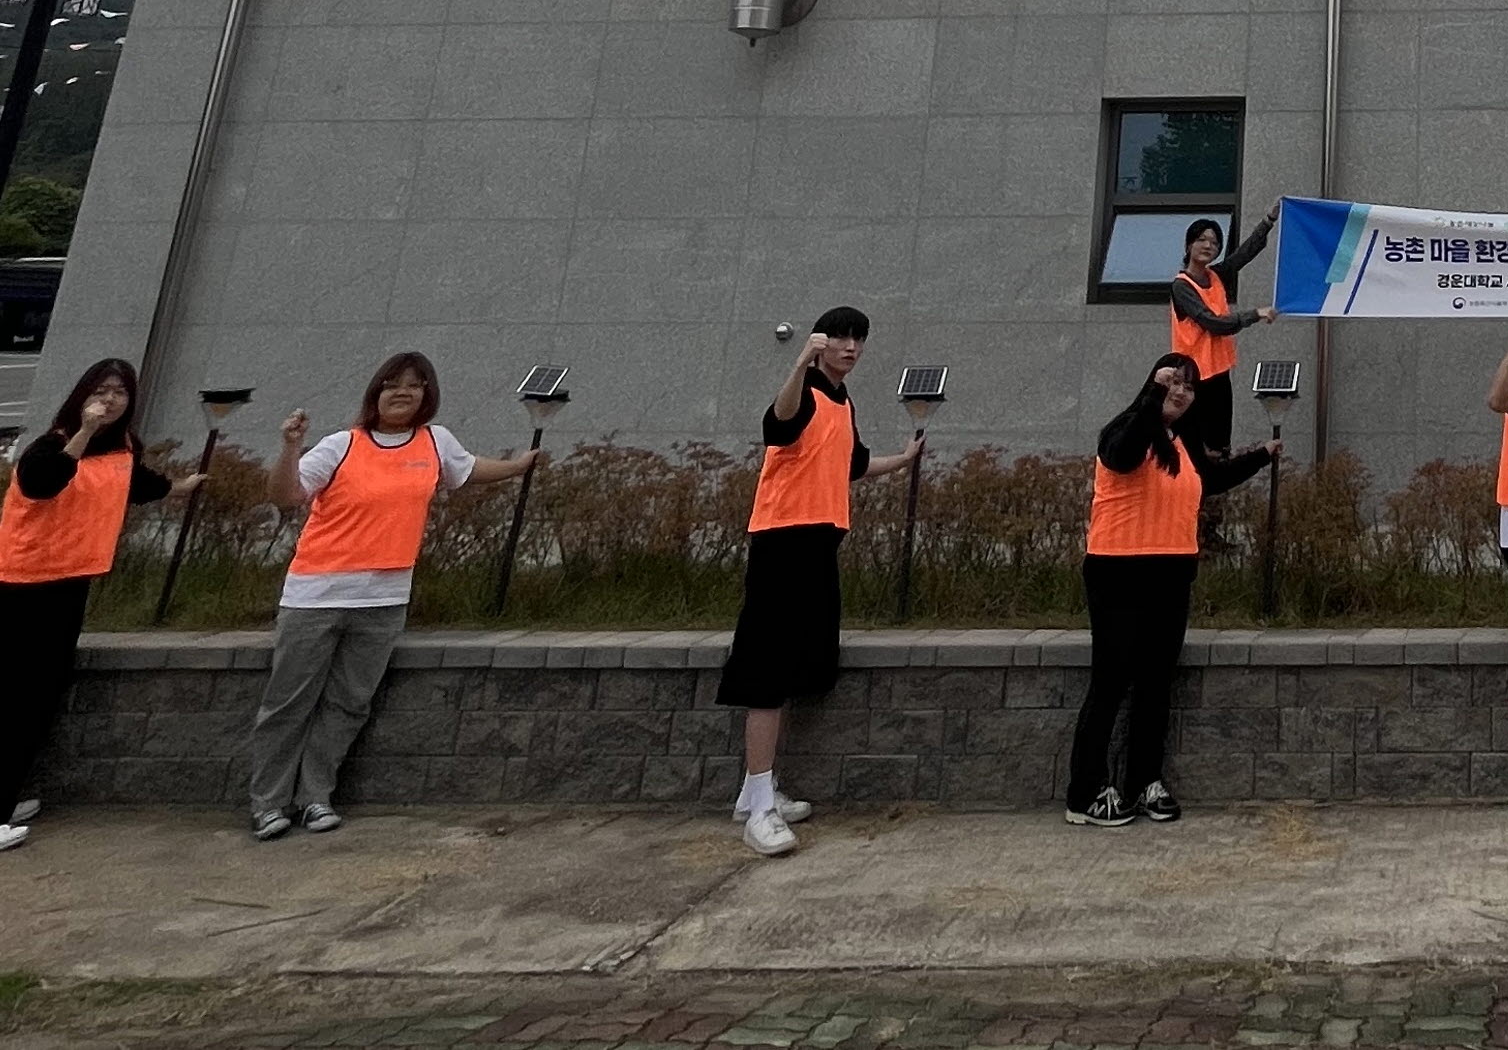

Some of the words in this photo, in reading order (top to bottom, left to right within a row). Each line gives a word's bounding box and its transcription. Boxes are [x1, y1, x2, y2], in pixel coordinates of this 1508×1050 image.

[1384, 236, 1425, 263] 농촌
[1430, 238, 1470, 263] 마을
[1437, 274, 1504, 288] 경운대학교
